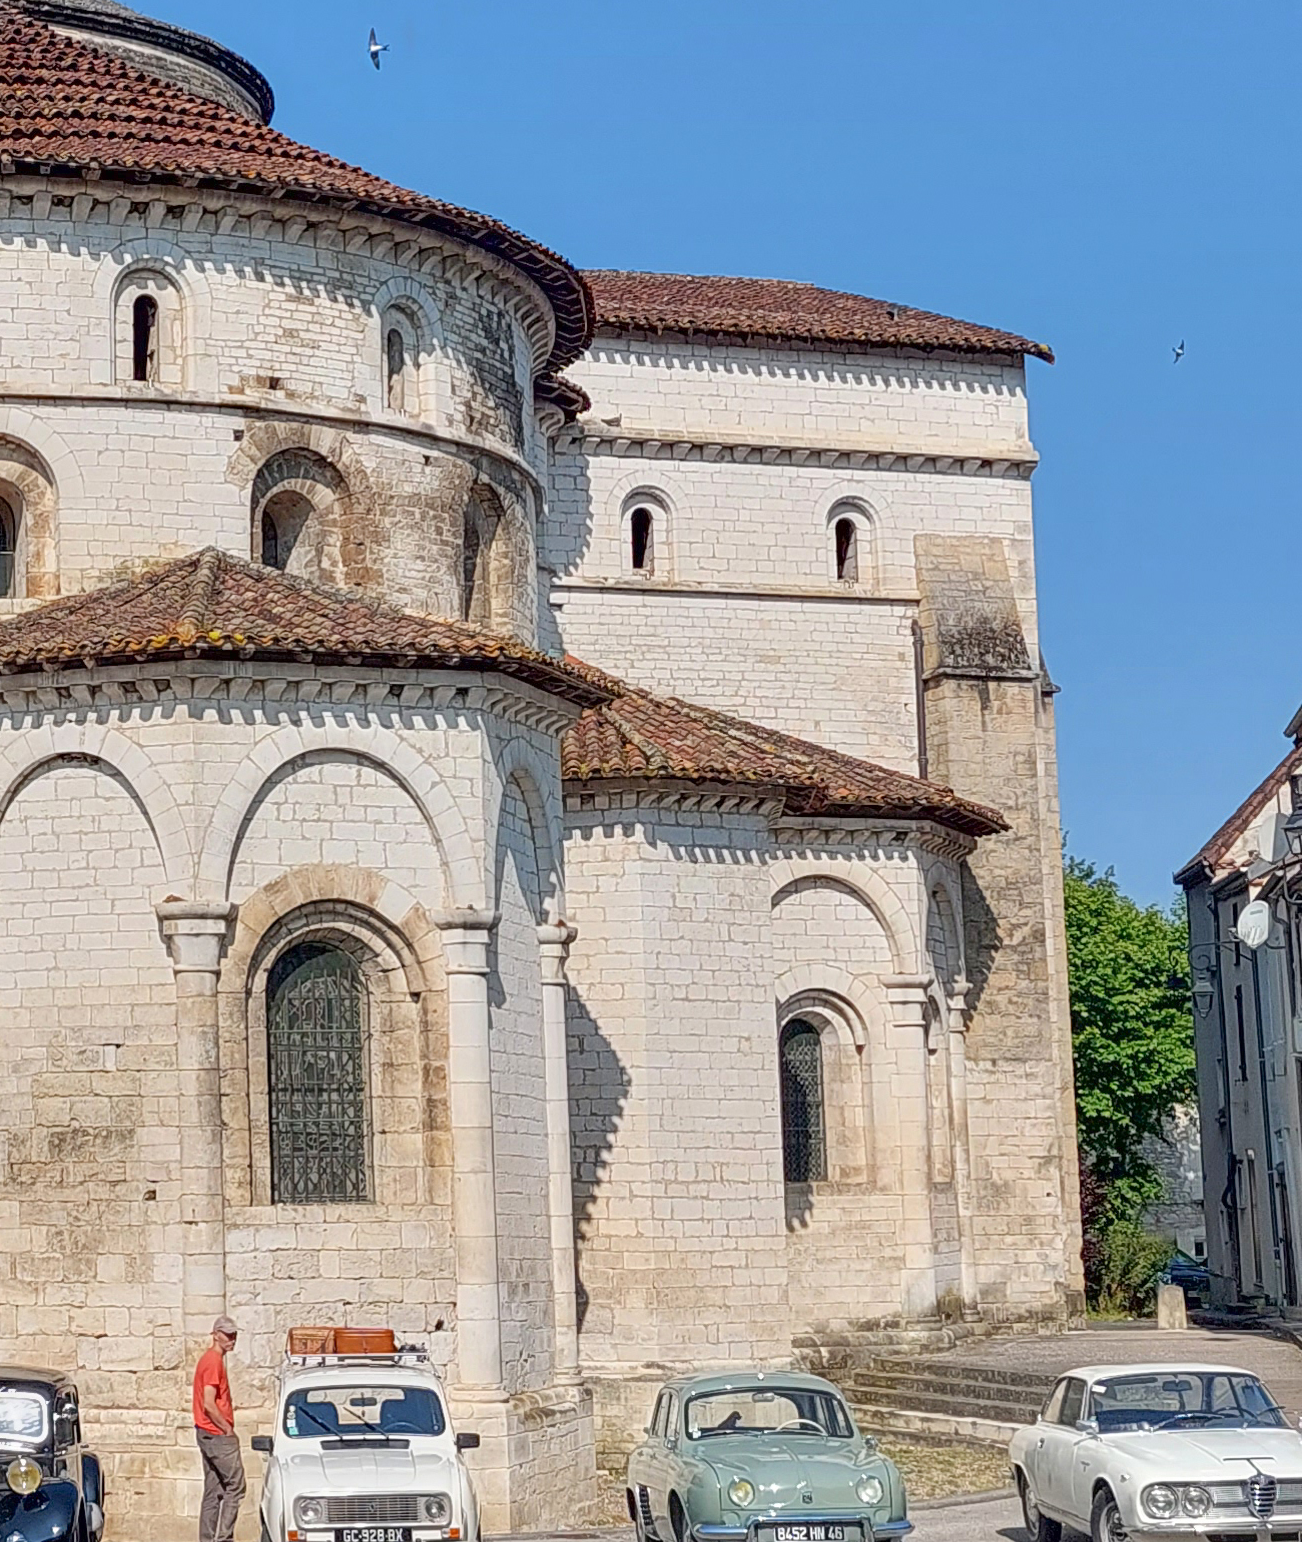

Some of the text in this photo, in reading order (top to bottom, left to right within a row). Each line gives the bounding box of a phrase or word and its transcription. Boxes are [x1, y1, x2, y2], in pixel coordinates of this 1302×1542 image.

[777, 1525, 843, 1541] 8452 HN 46
